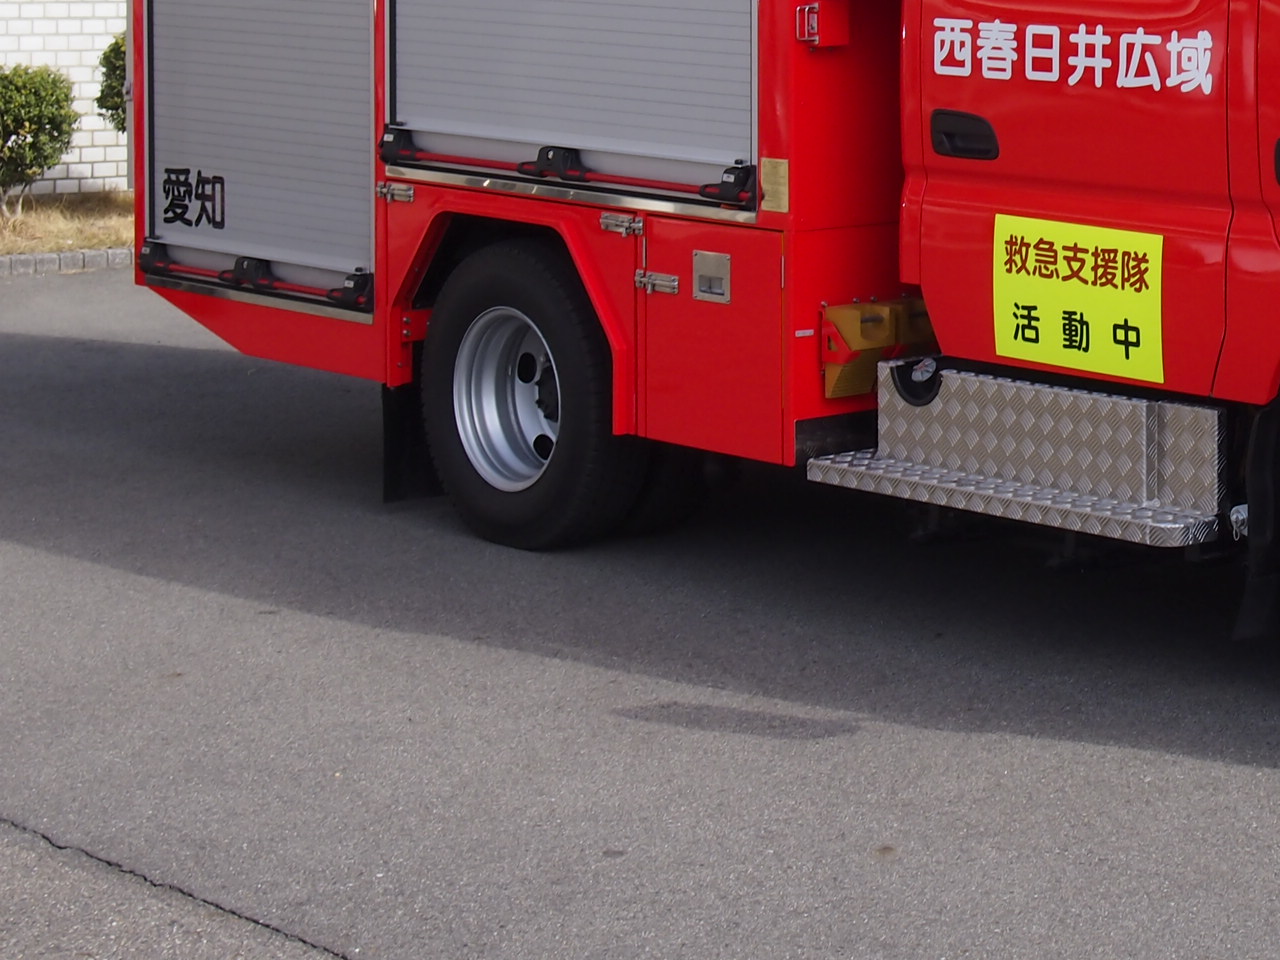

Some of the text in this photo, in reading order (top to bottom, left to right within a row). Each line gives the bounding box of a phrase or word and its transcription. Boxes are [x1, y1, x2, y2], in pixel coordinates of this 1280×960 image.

[933, 18, 1213, 95] 西春日井広域
[163, 168, 225, 230] 愛知
[1004, 234, 1150, 293] 救急支援隊
[1012, 301, 1142, 360] 活動中
